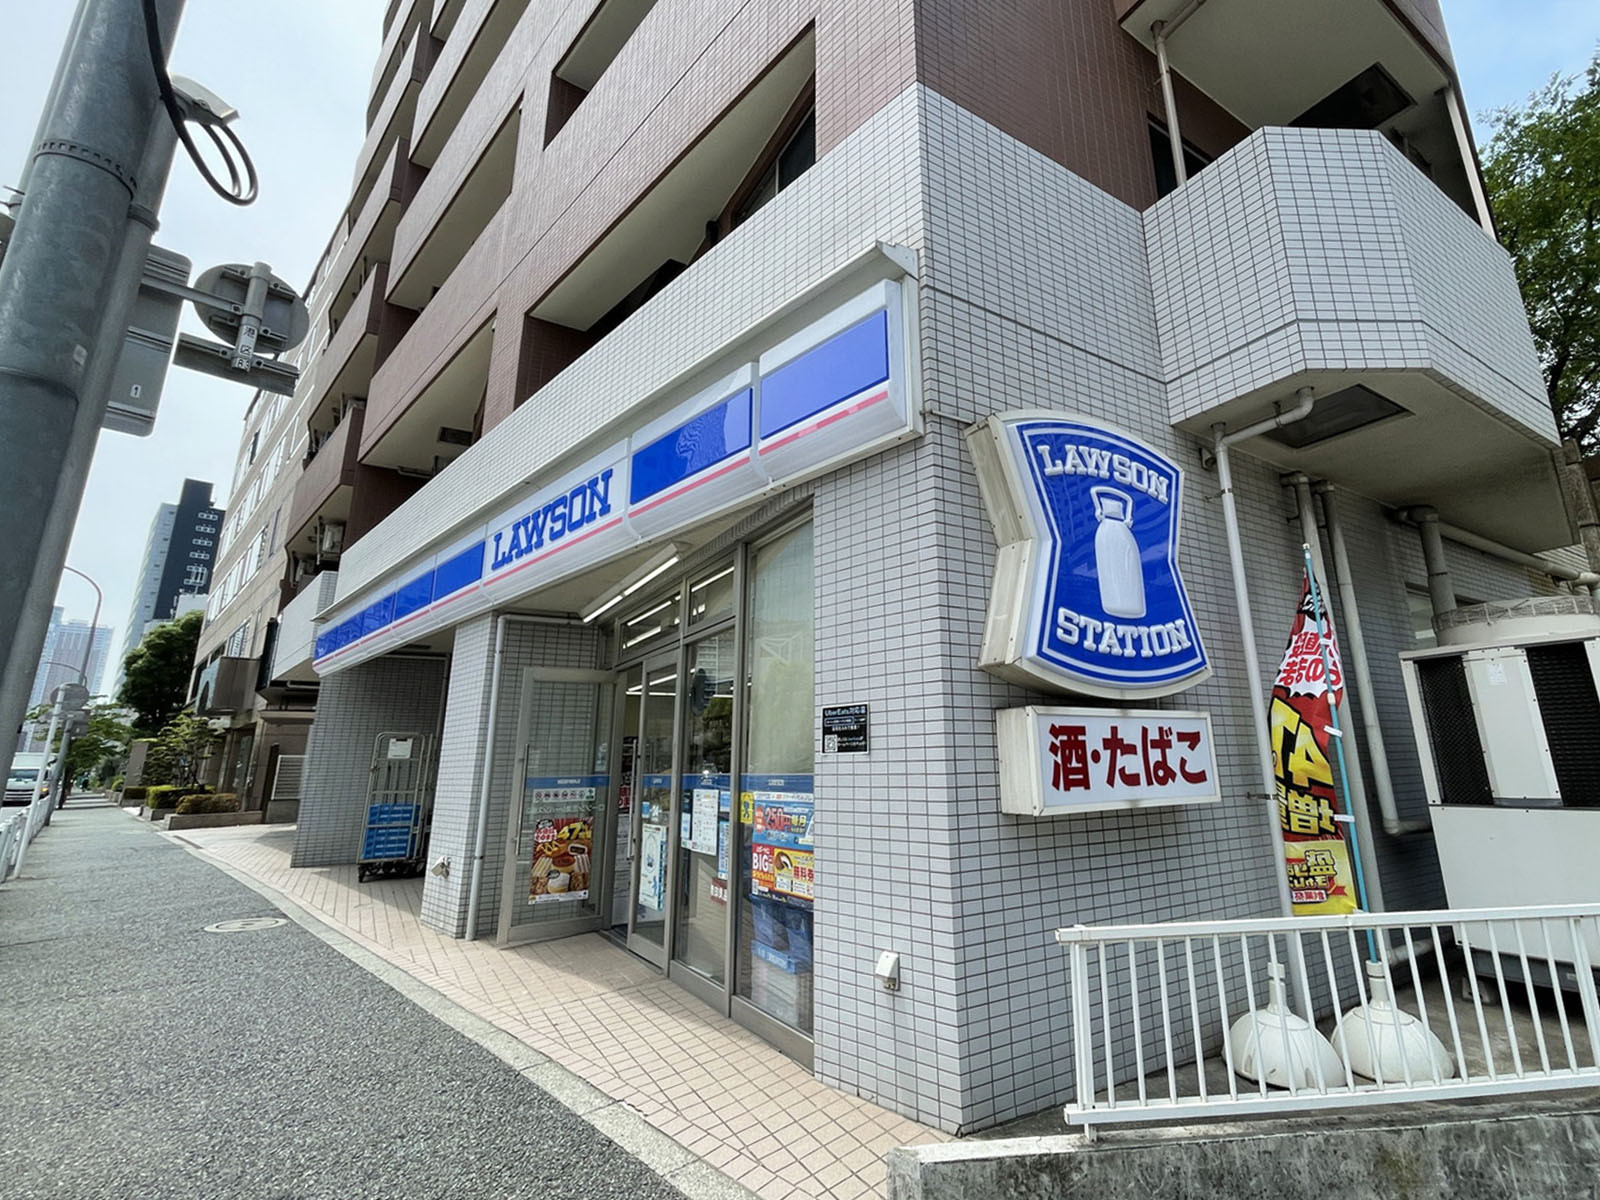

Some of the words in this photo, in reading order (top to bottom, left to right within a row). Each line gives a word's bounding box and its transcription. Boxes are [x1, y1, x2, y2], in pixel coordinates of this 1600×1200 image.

[1037, 444, 1169, 504] LAWSON
[491, 468, 613, 571] LAWSON
[1056, 606, 1191, 657] STATION
[1048, 723, 1208, 792] 酒・たばこ
[752, 853, 769, 873] BIG
